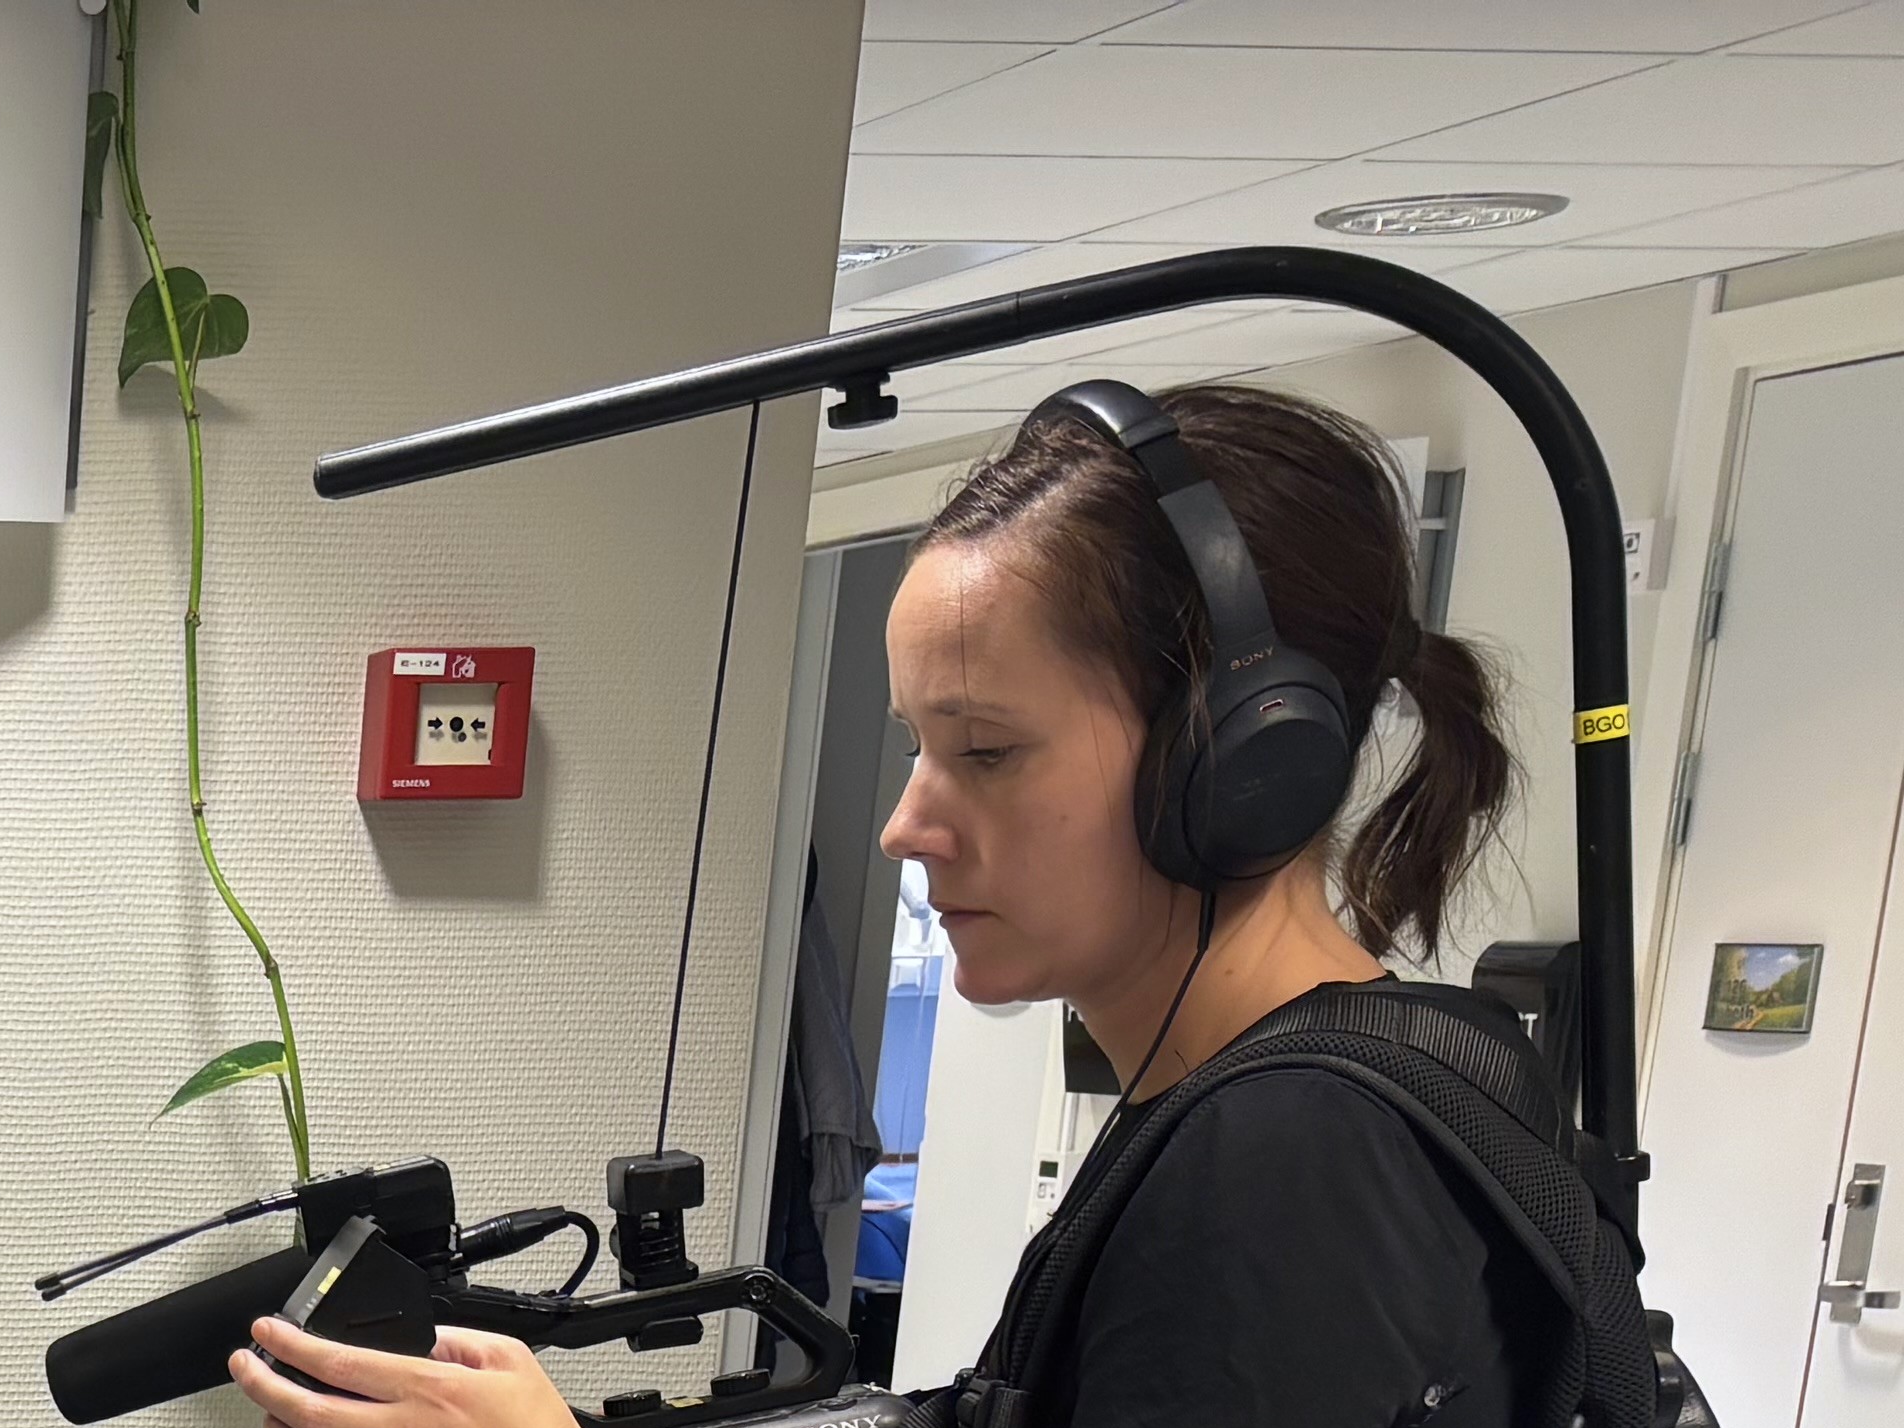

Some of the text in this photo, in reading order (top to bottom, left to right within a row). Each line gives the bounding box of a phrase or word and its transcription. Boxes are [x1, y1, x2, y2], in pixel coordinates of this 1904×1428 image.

[1230, 647, 1273, 670] SONY
[1583, 713, 1625, 736] BGO
[392, 779, 431, 788] SIEMENS
